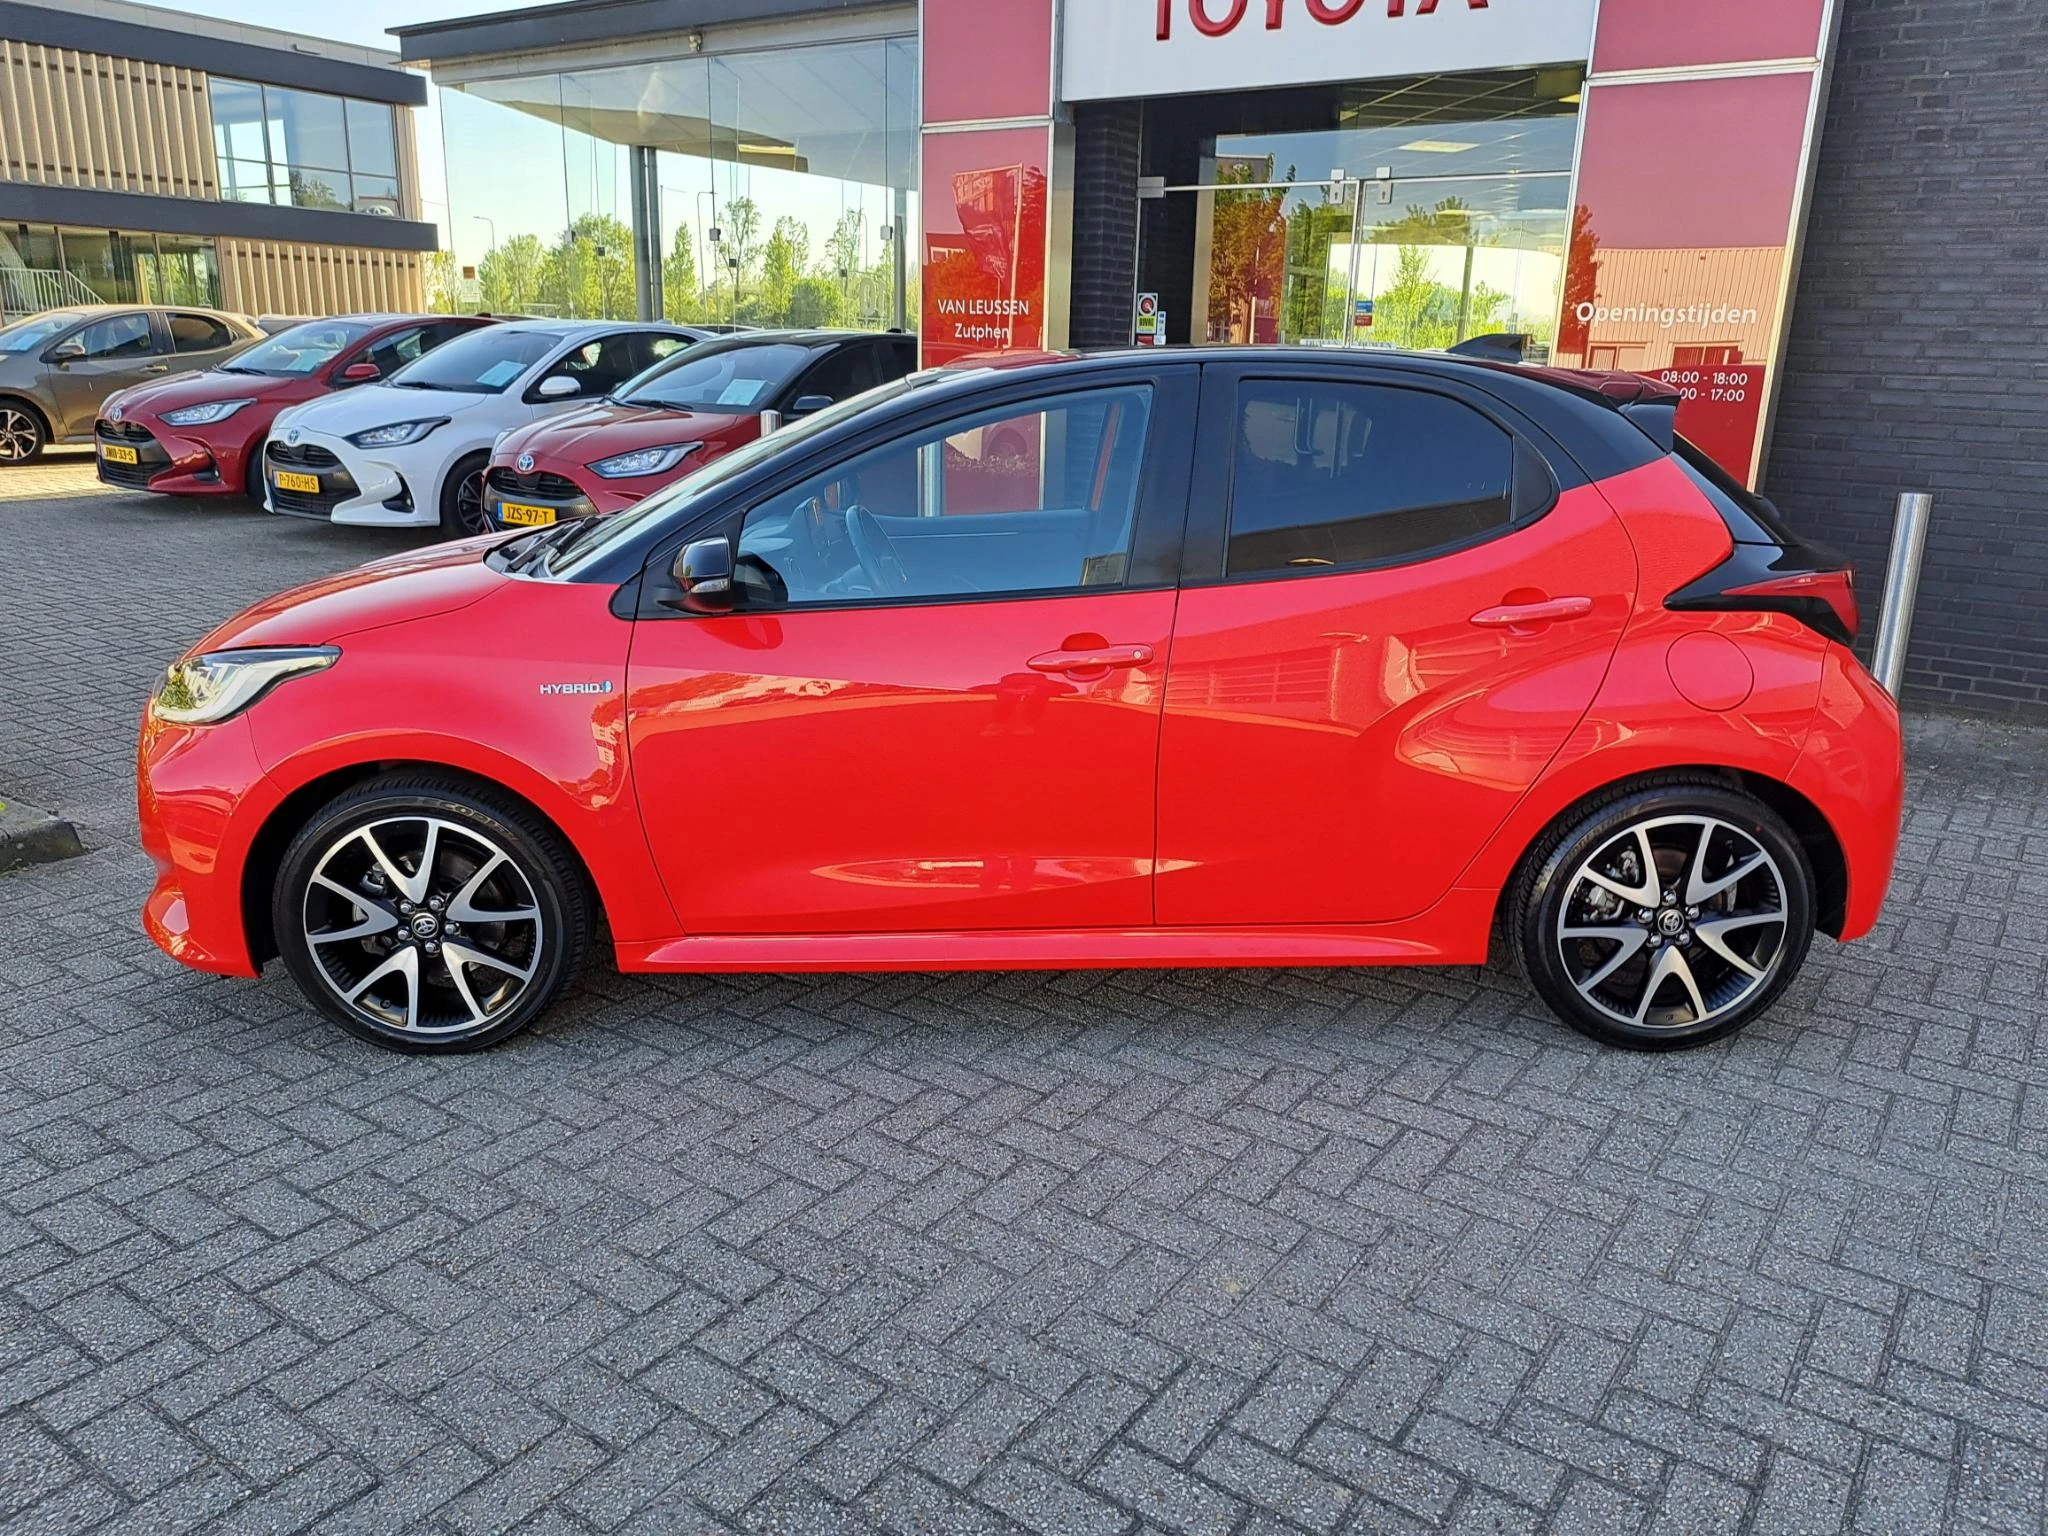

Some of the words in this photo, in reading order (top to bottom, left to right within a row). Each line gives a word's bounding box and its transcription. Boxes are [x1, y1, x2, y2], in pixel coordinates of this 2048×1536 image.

[938, 299, 965, 314] VAN
[969, 299, 1029, 315] LEUSSEN
[1576, 302, 1757, 328] Openingstijden
[954, 322, 1009, 342] Zutphen
[1661, 370, 1700, 384] 08:00
[1712, 372, 1748, 385] 18:00
[1710, 388, 1745, 402] 17:00
[279, 474, 316, 490] P-760-HS
[505, 505, 549, 524] JZS-97-T
[540, 683, 600, 694] HYBRID
